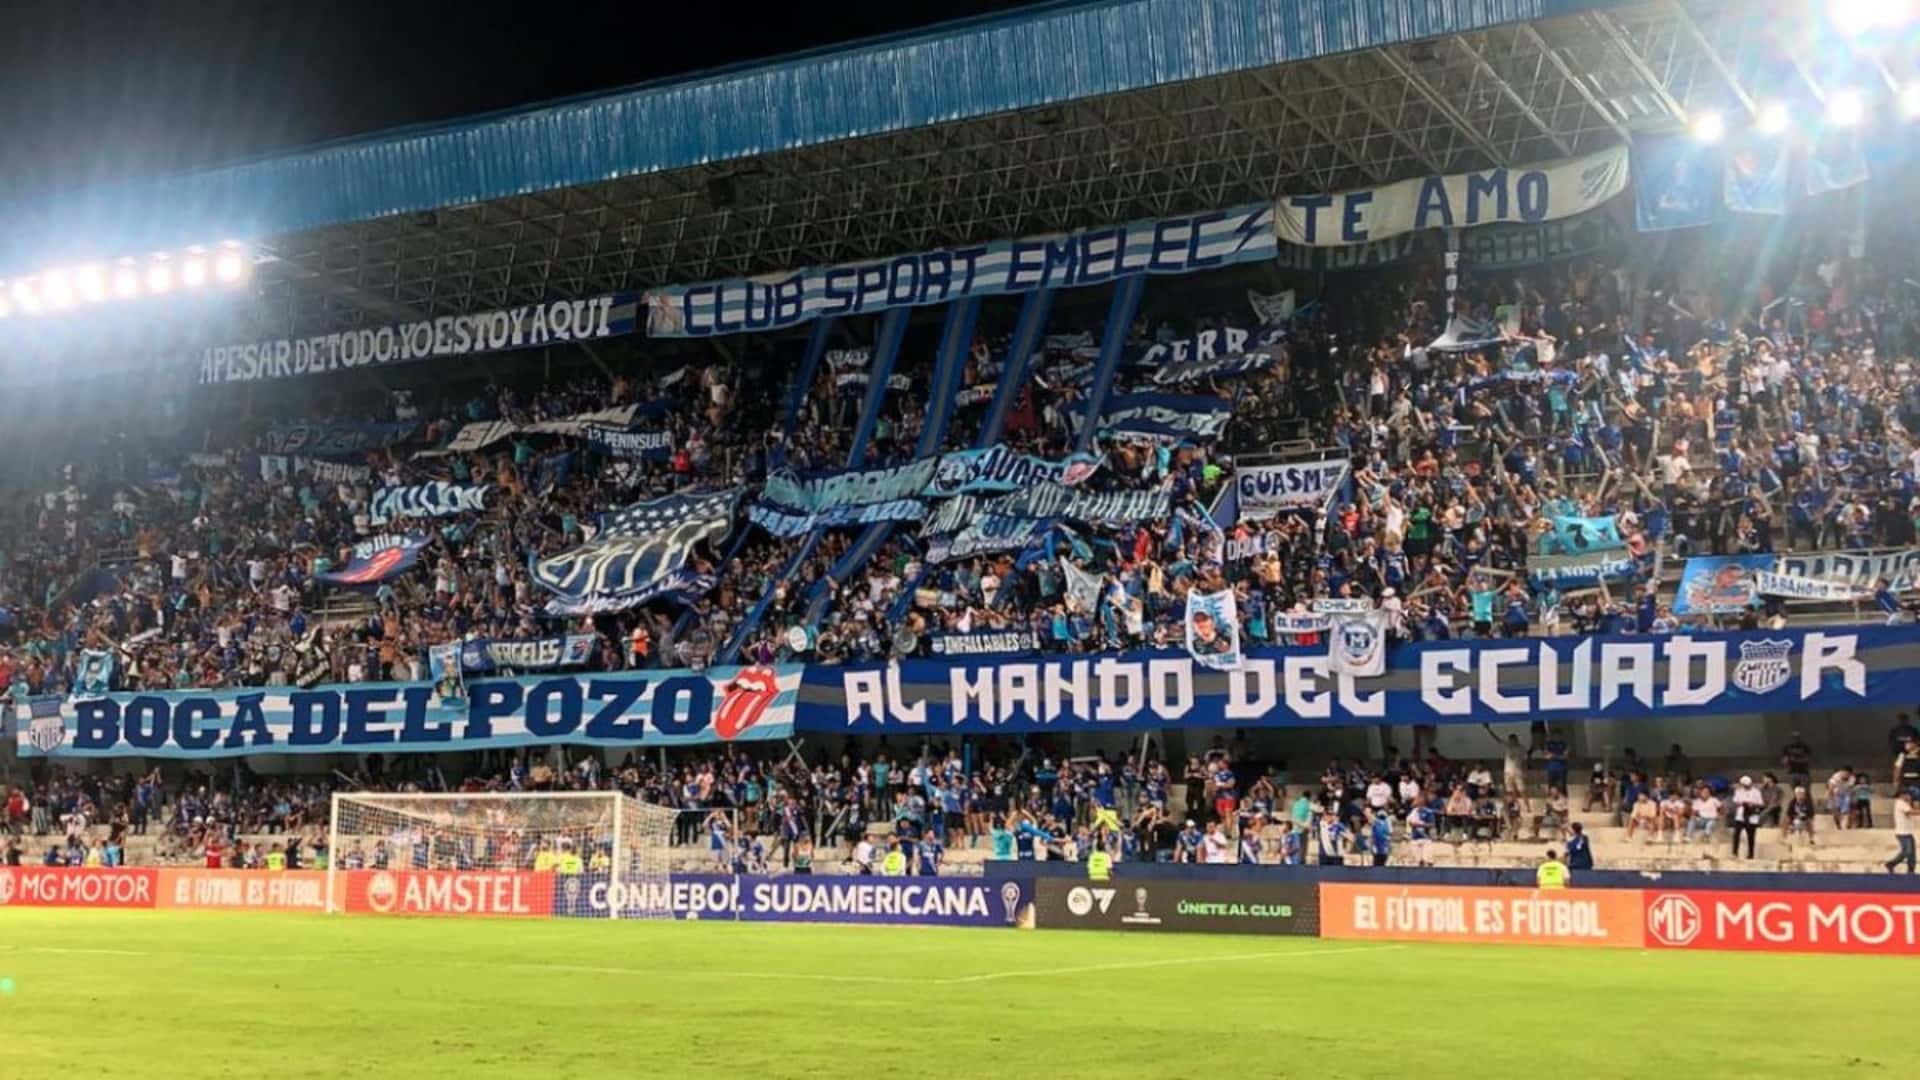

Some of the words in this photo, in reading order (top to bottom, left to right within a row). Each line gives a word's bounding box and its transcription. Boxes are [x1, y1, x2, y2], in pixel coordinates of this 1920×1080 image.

[1291, 191, 1373, 243] TE
[1415, 167, 1549, 230] AMO
[684, 275, 804, 335] CLUB
[819, 247, 988, 316] SPORT
[1005, 211, 1227, 291] EMELEC
[530, 297, 614, 345] AQUI
[1240, 467, 1342, 497] GUASM
[844, 664, 927, 726] AL
[950, 657, 1195, 727] MANDO
[1225, 653, 1386, 718] DEL
[73, 692, 274, 750] BOCA
[288, 686, 452, 746] DEL
[463, 675, 714, 740] POZO
[20, 873, 57, 902] MG
[61, 874, 151, 903] MOTOR
[402, 874, 530, 913] AMSTEL
[753, 883, 989, 917] SUDAMERICANA
[1177, 899, 1227, 916] ÚNETE
[1229, 903, 1248, 916] AL
[1250, 904, 1293, 917] CLUB
[1354, 895, 1379, 930] EL
[1385, 888, 1468, 934] FÚTBOL
[1475, 898, 1504, 933] ES
[1654, 899, 1697, 941] MG
[1716, 901, 1794, 943] MG
